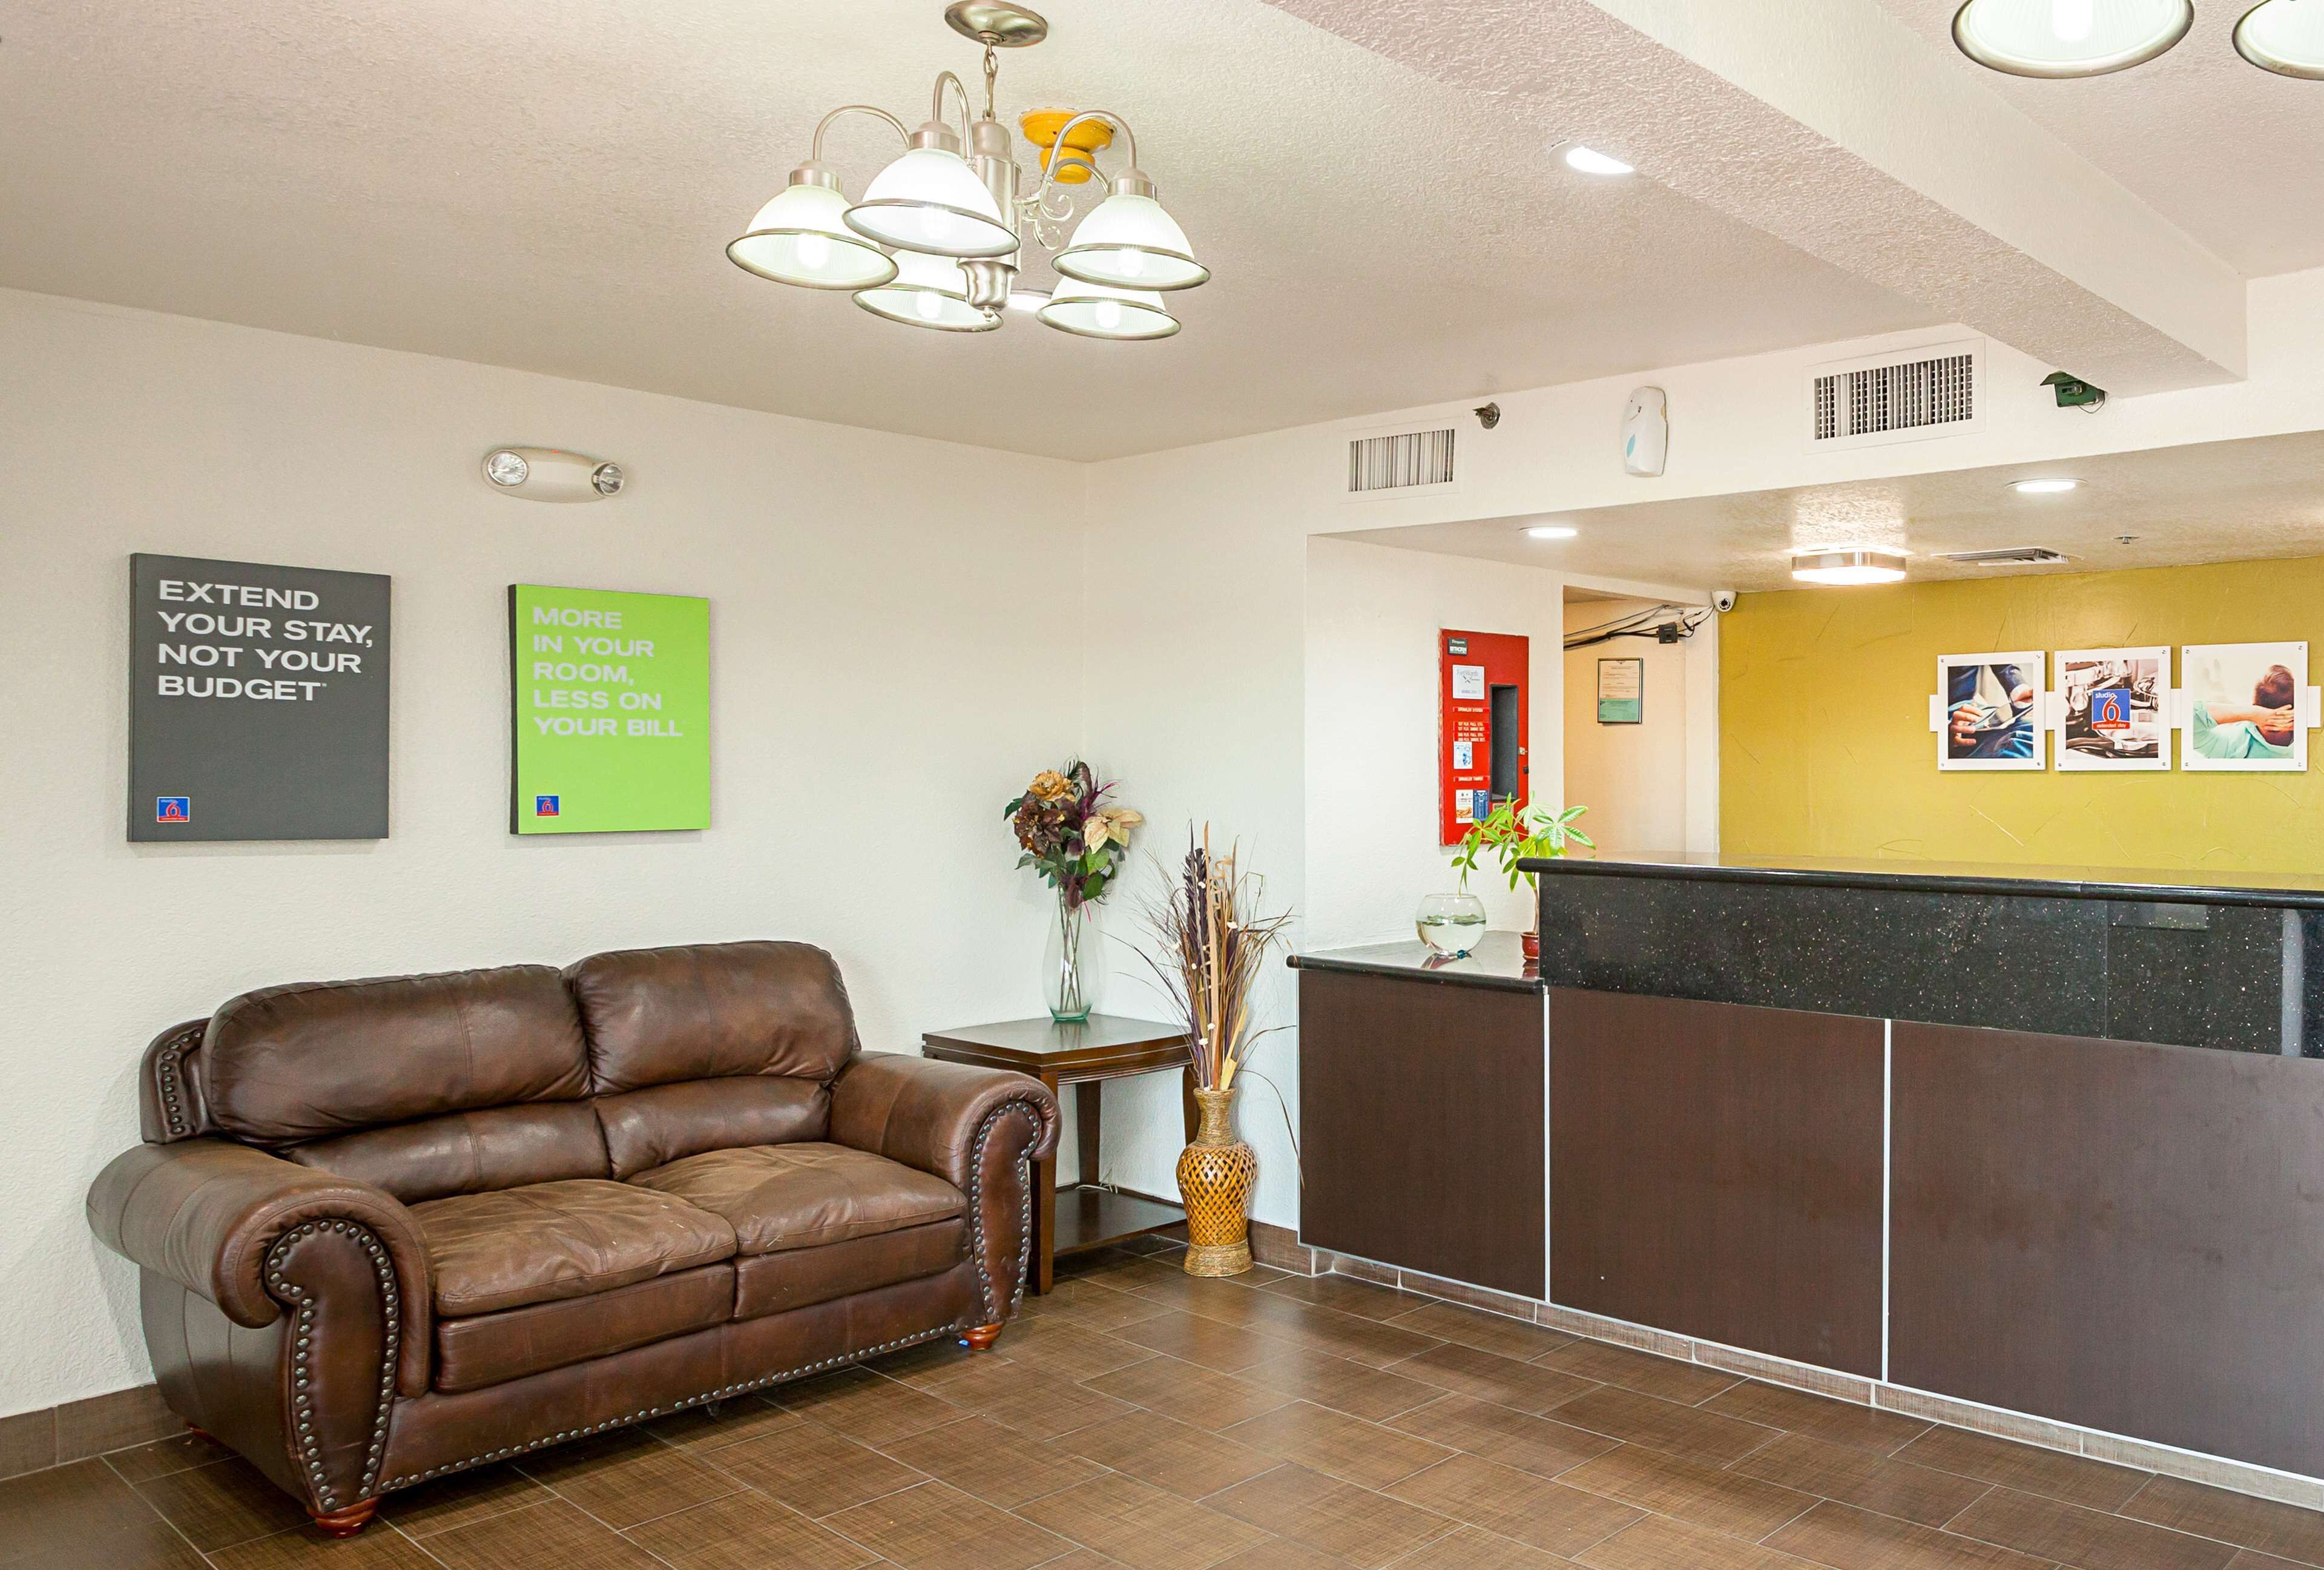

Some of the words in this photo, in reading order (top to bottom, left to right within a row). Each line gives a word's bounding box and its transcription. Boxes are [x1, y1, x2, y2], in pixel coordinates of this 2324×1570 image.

[159, 579, 319, 610] EXTEND
[157, 611, 272, 638] YOUR
[283, 620, 373, 648] STAY,
[533, 607, 622, 629] MORE
[158, 643, 243, 667] NOT
[255, 648, 361, 673] YOUR
[533, 635, 562, 653] IN
[573, 636, 654, 658] YOUR
[533, 662, 634, 686] ROOM,
[533, 689, 610, 709] LESS
[619, 692, 662, 710] ON
[2102, 694, 2121, 722] 6
[533, 716, 617, 736] YOUR
[627, 719, 683, 737] BILL
[166, 799, 180, 817] 6
[542, 797, 553, 812] 6
